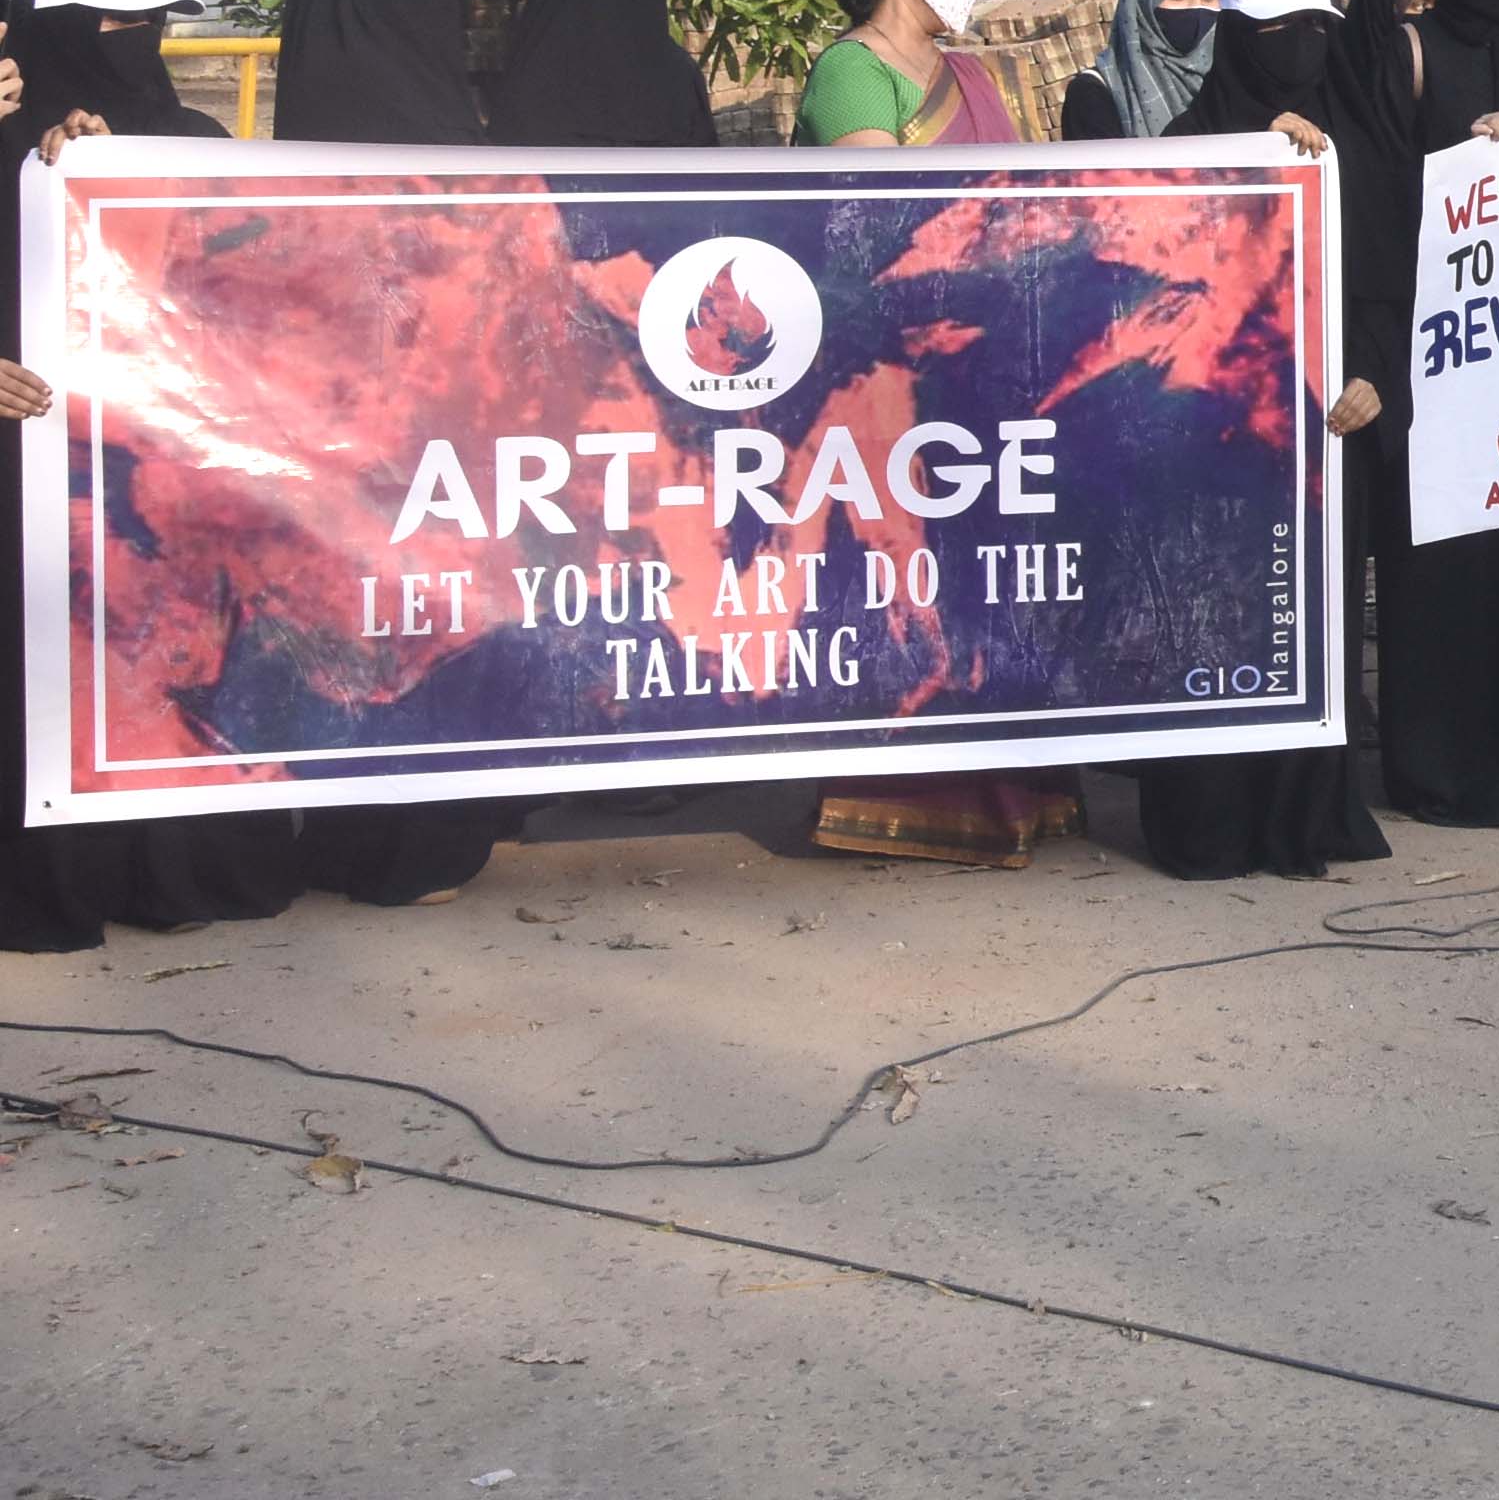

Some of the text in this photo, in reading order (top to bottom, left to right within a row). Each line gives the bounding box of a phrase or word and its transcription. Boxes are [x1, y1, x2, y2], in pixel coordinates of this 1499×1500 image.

[1446, 239, 1494, 293] TO
[389, 418, 1057, 545] ART-RAGE
[360, 541, 1085, 639] LET YOUR ART DO THE
[1265, 521, 1296, 694] Mangalore
[606, 625, 861, 702] TALKING
[1184, 663, 1263, 699] GIO
